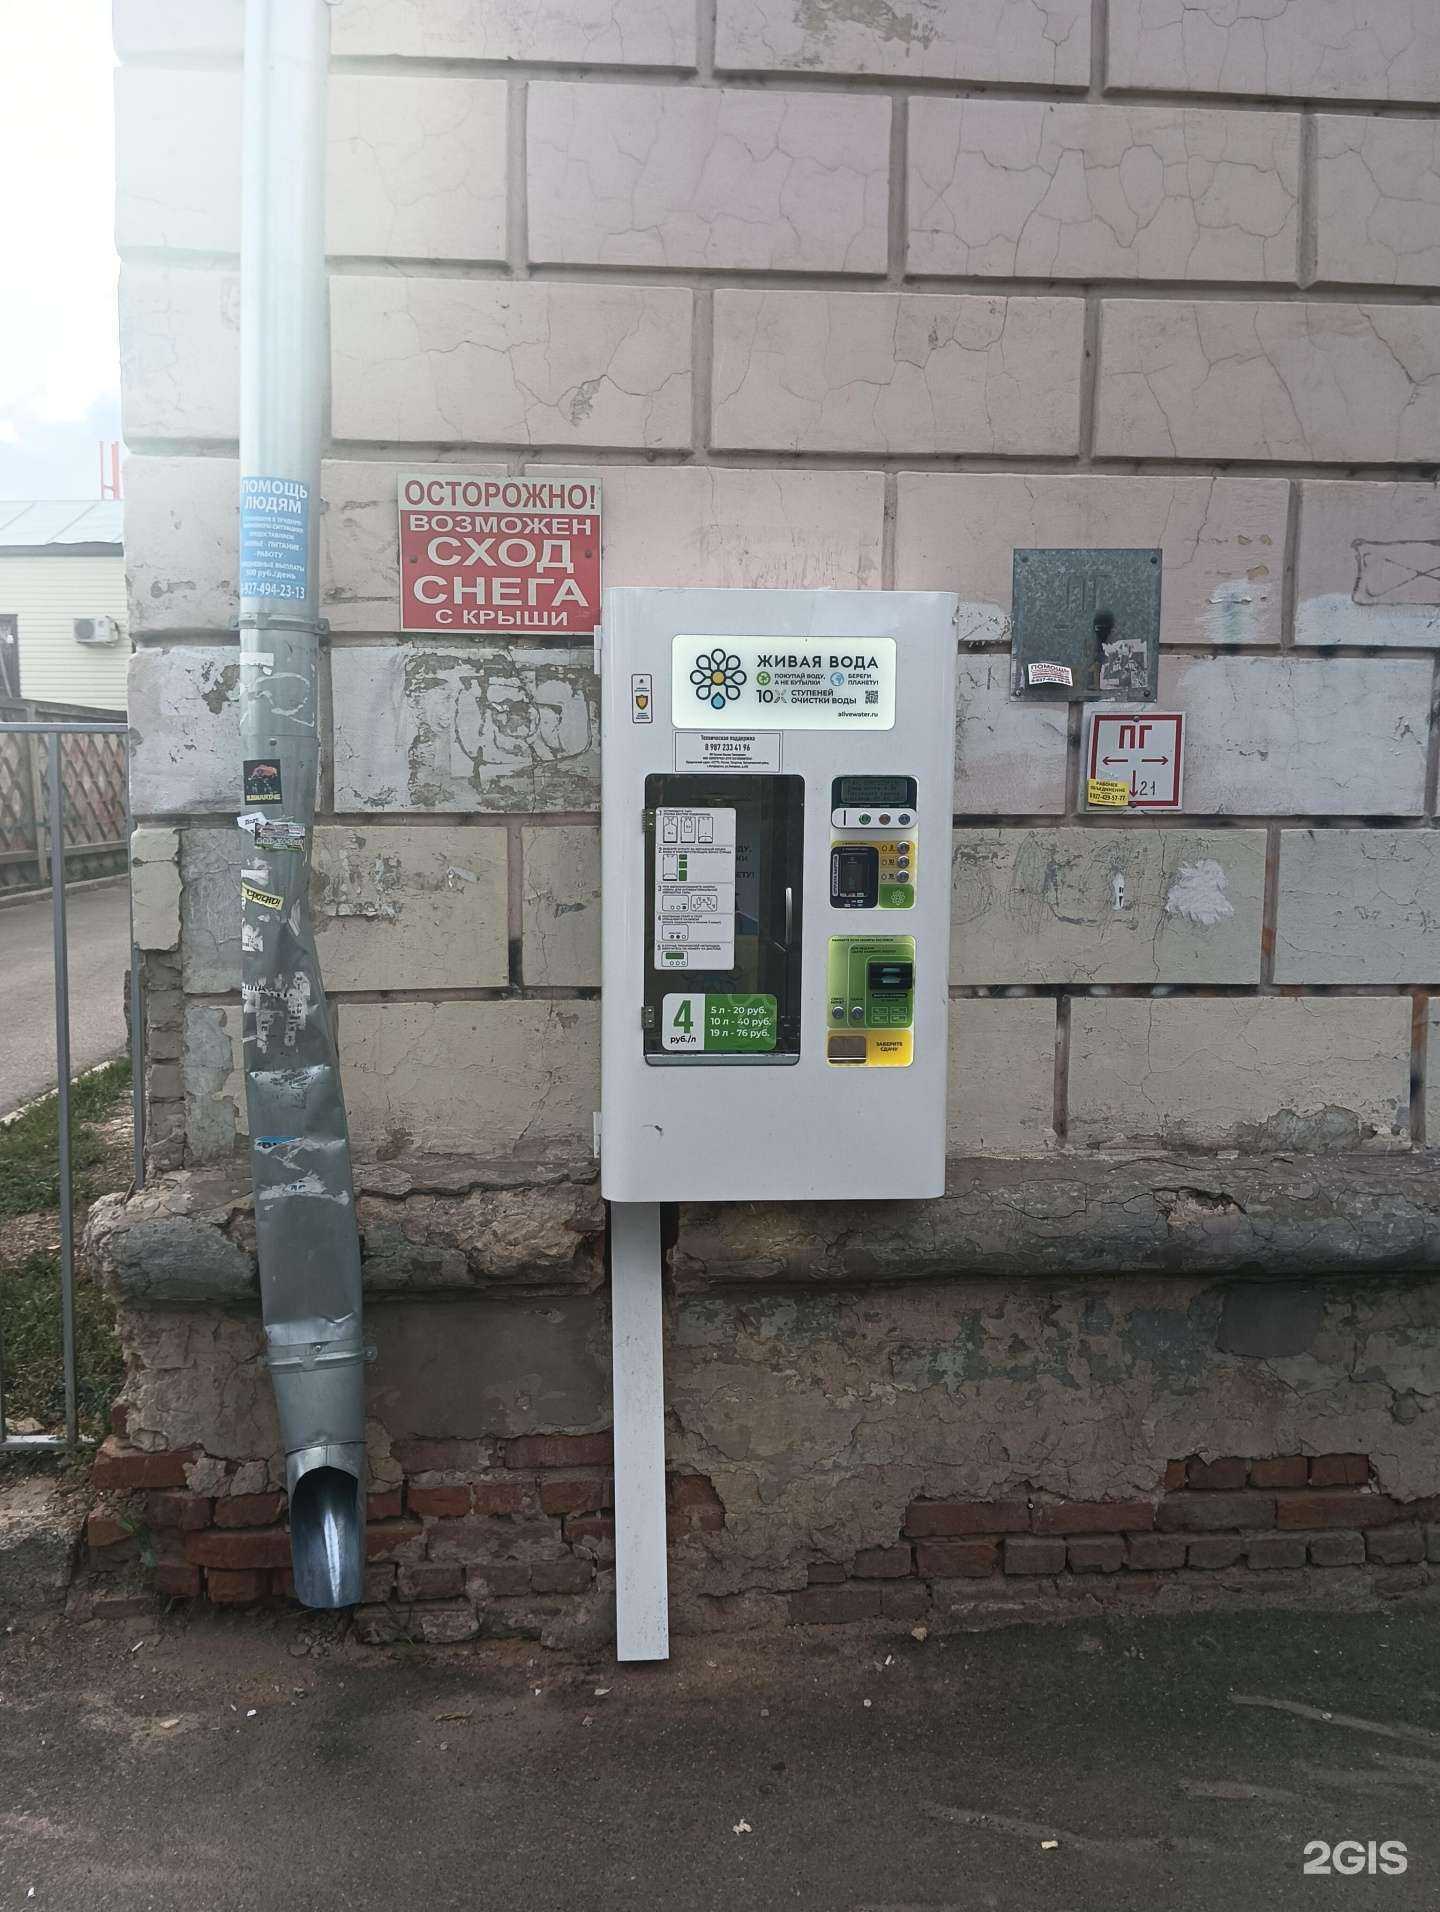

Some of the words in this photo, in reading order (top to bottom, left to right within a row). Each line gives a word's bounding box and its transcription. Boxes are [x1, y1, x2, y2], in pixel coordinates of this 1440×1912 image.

[241, 479, 308, 500] ПОМОЩЬ
[404, 479, 596, 510] ОСТОРОЖНО!
[244, 495, 302, 514] ЛЮДЯМ
[409, 514, 591, 536] ВОЗМОЖЕН
[427, 536, 575, 574] СХОД
[413, 575, 589, 607] СНЕГА
[435, 609, 453, 624] С
[463, 610, 568, 626] КРЫШИ
[757, 655, 822, 668] ЖИВАЯ
[829, 655, 879, 670] ВОДА
[774, 672, 805, 680] ПОКУПАЙ
[791, 688, 834, 697] СТУПЕНЕЙ
[832, 697, 857, 705] ВОДЫ
[1118, 724, 1153, 749] ПГ
[704, 743, 709, 751] 8
[710, 743, 721, 751] 987
[722, 743, 733, 751] 233
[1139, 780, 1156, 796] 21
[673, 1000, 694, 1034] 4
[711, 1006, 717, 1014] 5
[733, 1006, 745, 1014] 20
[747, 1006, 767, 1016] руб.
[737, 1017, 750, 1025] 40
[752, 1017, 772, 1026] руб.
[670, 1035, 697, 1044] руб./л
[710, 1029, 720, 1037] 19
[736, 1029, 748, 1037] 76
[750, 1028, 770, 1038] руб.
